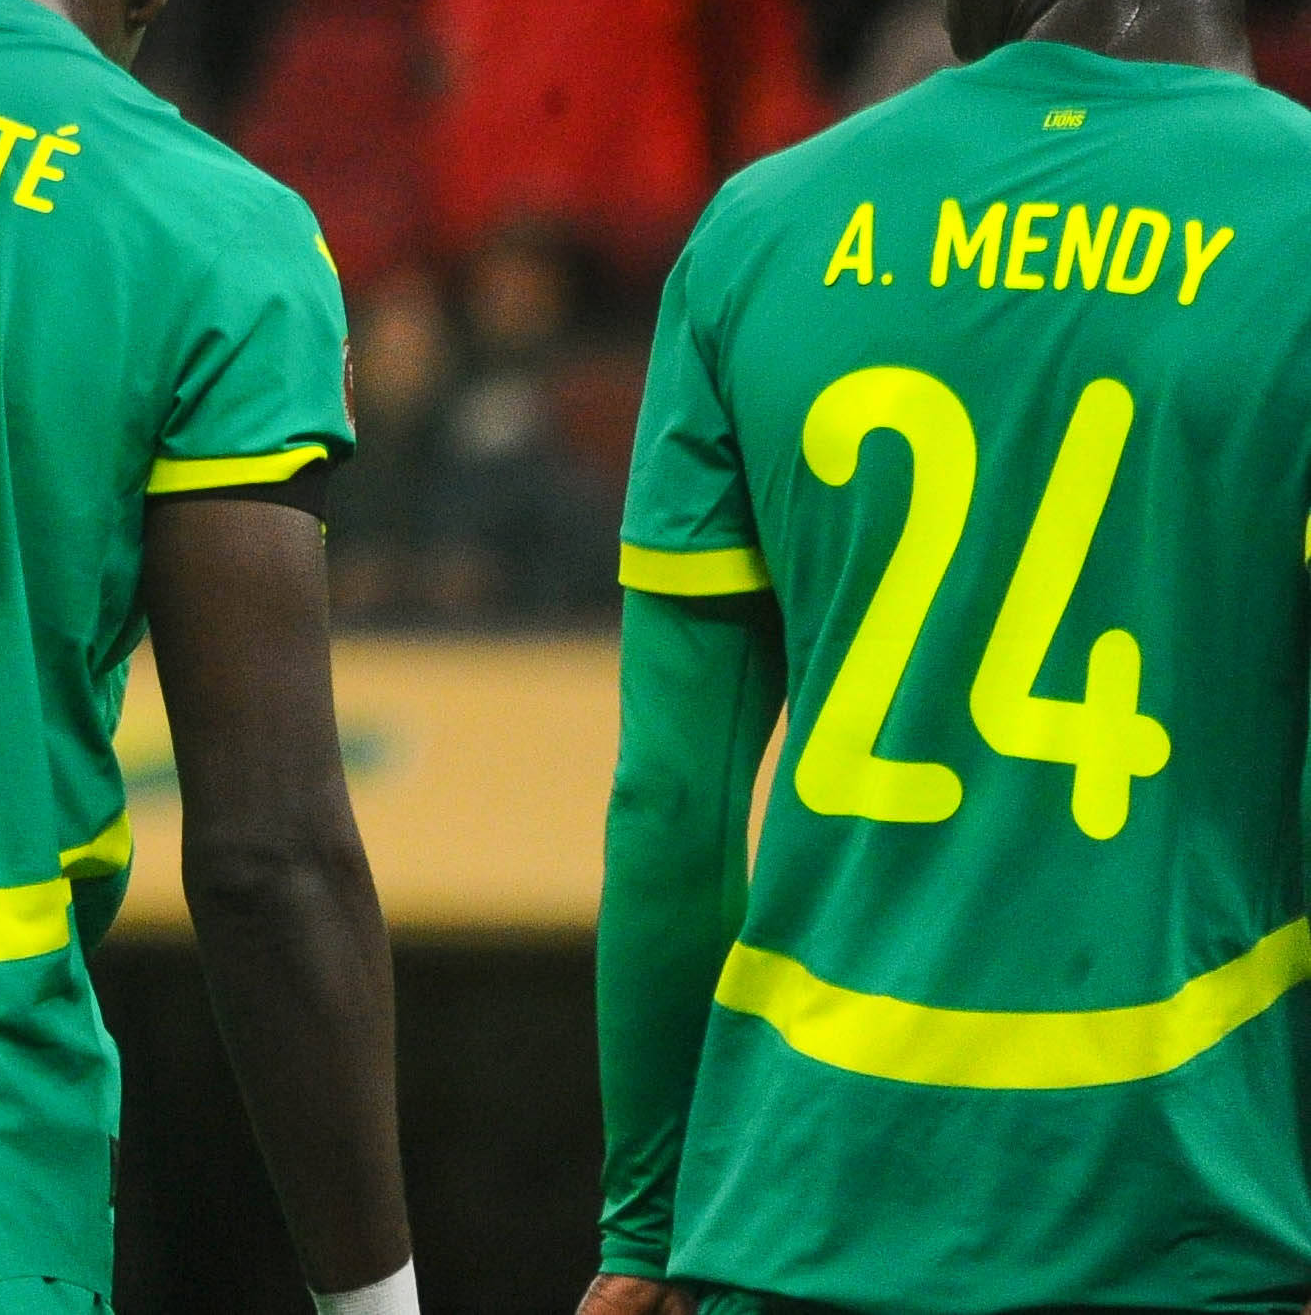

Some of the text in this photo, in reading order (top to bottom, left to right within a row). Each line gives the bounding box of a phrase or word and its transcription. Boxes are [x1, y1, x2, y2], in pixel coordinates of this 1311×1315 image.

[1043, 113, 1085, 128] LIONS
[824, 199, 1234, 306] A. MENDY
[795, 366, 1171, 840] 24
